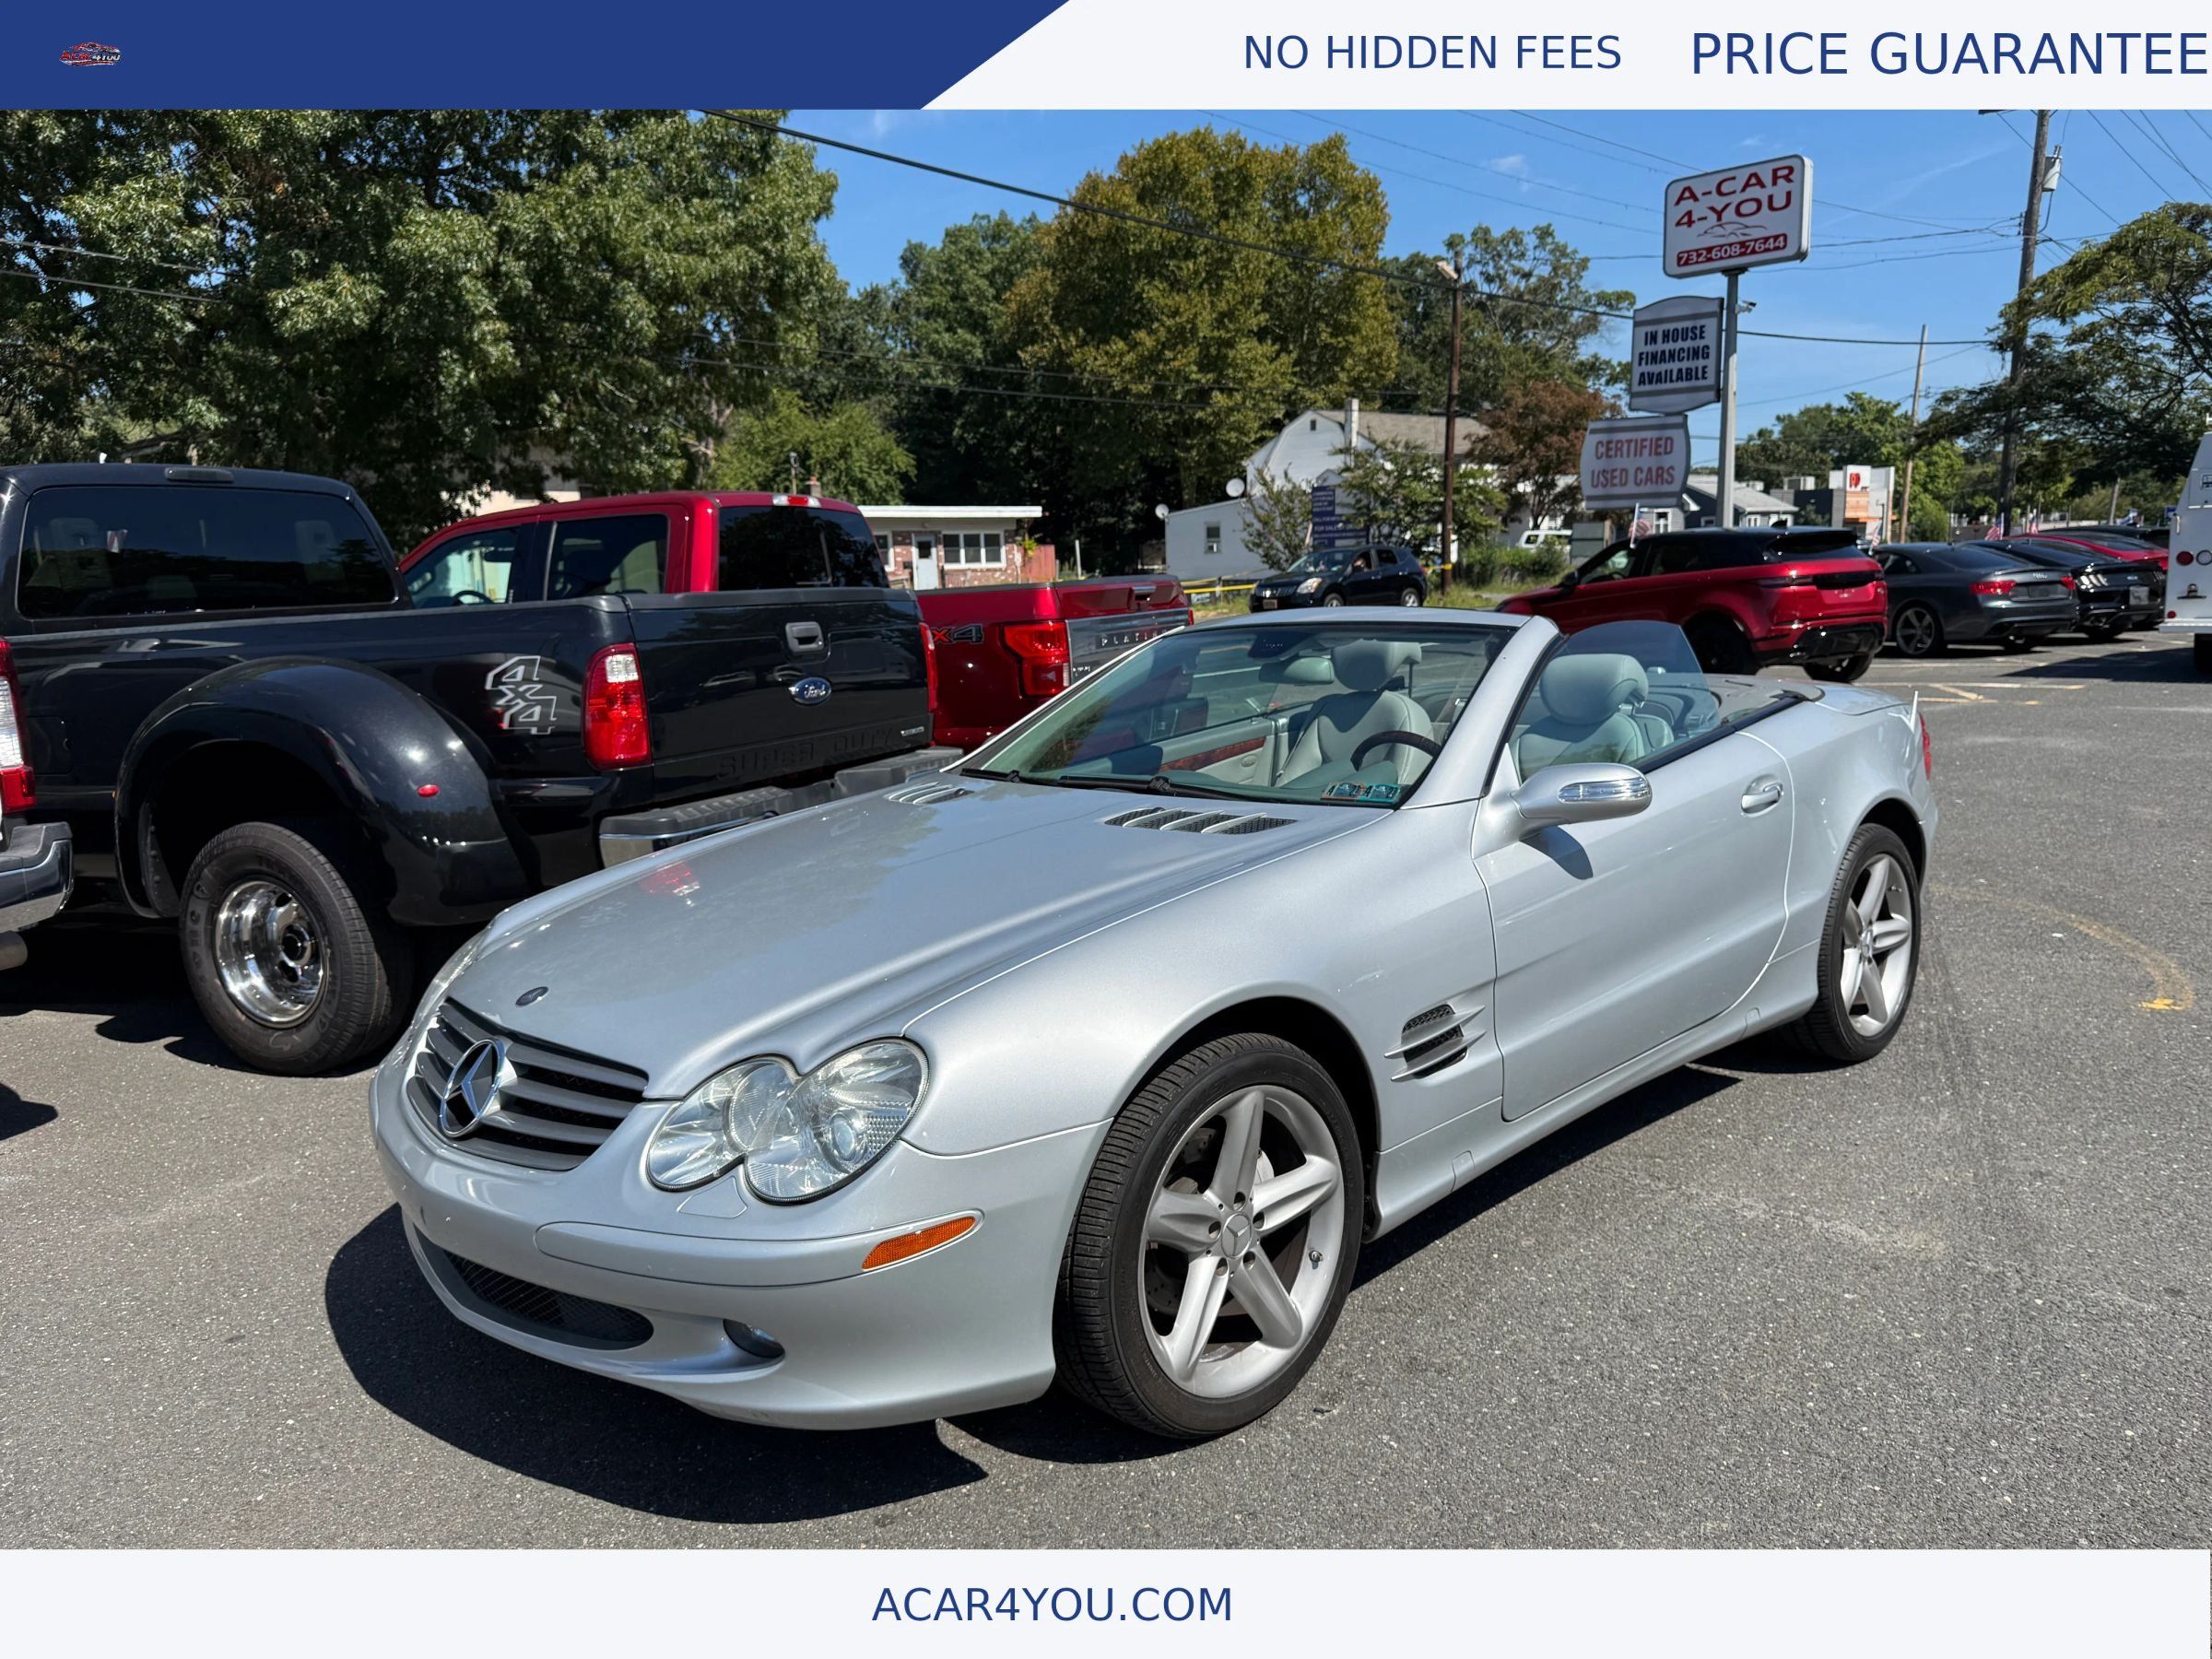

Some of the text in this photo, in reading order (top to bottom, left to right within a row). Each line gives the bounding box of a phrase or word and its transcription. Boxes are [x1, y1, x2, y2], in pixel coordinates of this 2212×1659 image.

[1674, 165, 1794, 206] A-CAR
[1675, 190, 1792, 228] 4-YOU
[1678, 237, 1785, 265] 732-608-7644
[1643, 324, 1706, 346] IN HOUSE
[1638, 345, 1711, 367] FINANCING
[1638, 366, 1709, 386] AVAILABLE
[1595, 436, 1675, 460] CERTIFIED
[1591, 465, 1676, 488] USED CARS
[1101, 628, 1167, 647] PLATIN
